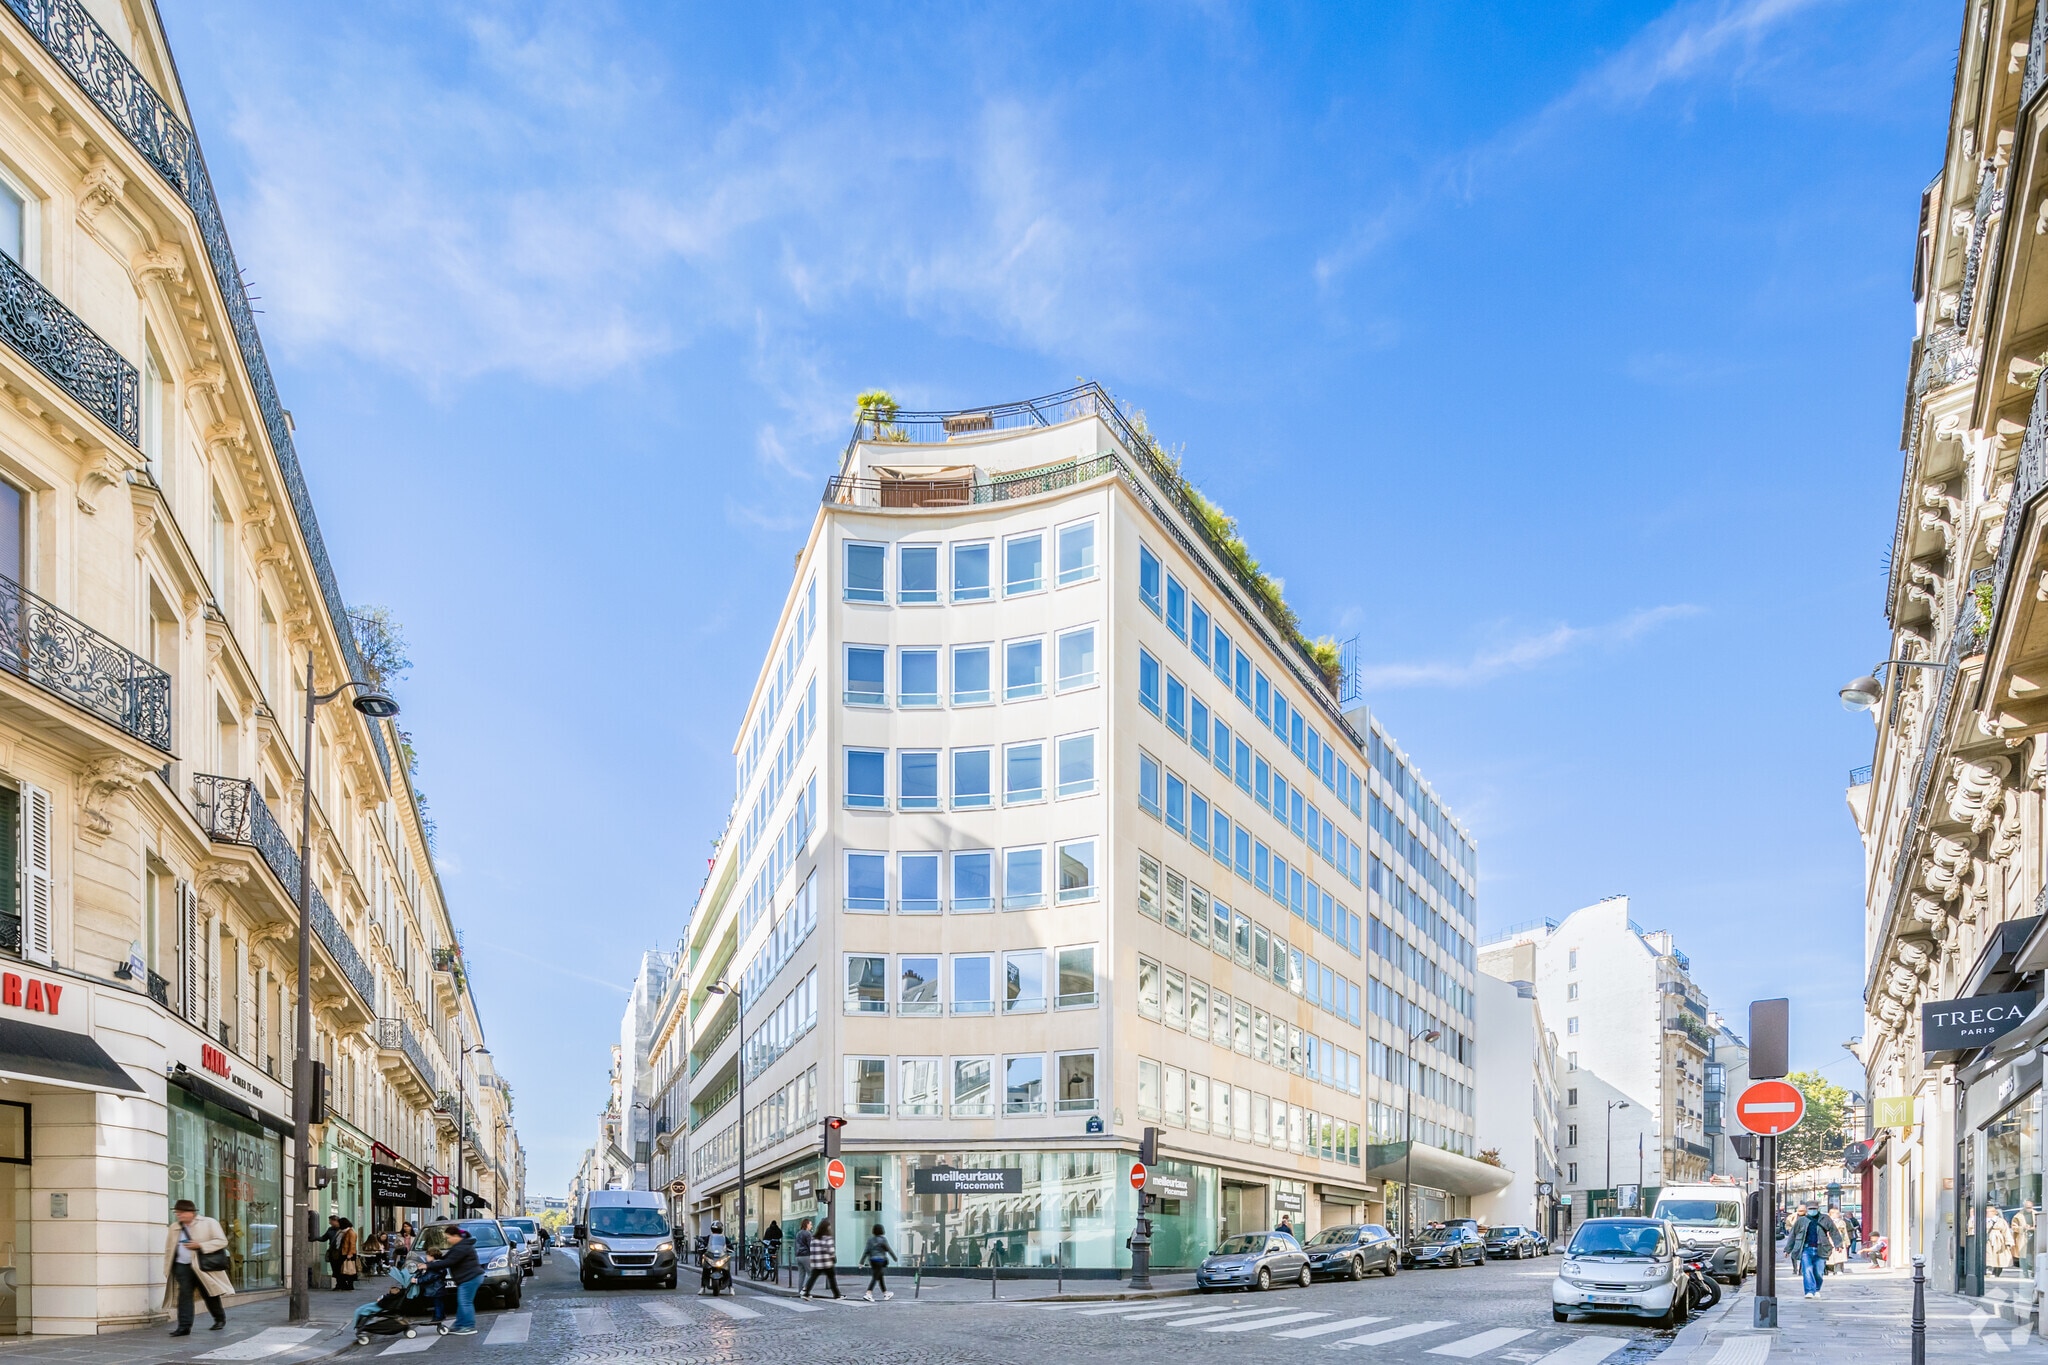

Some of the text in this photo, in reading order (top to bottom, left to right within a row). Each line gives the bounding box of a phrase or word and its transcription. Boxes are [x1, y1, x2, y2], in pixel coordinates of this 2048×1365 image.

[3, 972, 63, 1015] RAY
[1932, 1004, 2025, 1027] TRECA
[1961, 1027, 1995, 1036] PARIS
[212, 1137, 264, 1172] PROMOTIONS
[931, 1170, 1004, 1182] meilleurtaux
[955, 1182, 1004, 1190] Placement
